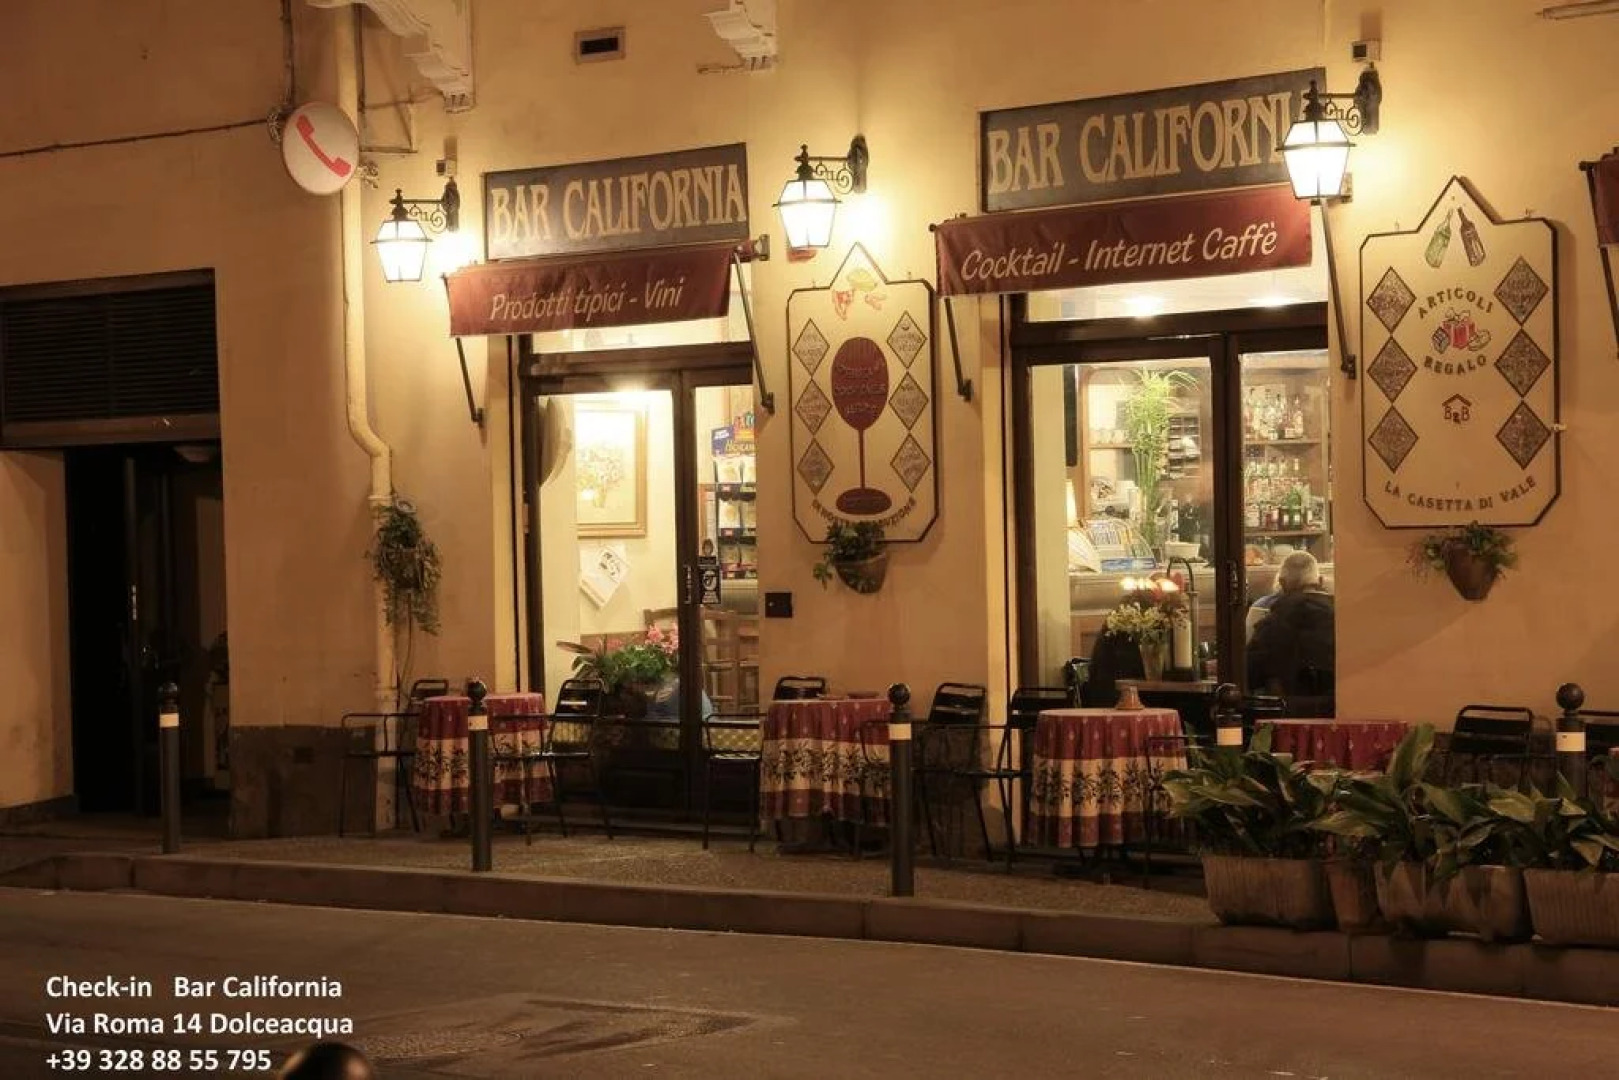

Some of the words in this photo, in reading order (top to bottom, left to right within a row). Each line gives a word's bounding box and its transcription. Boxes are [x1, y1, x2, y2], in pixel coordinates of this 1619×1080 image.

[986, 122, 1064, 194] BAR
[1079, 90, 1307, 183] CALIFORNI
[491, 184, 551, 242] BAR
[563, 163, 747, 240] CALIFORNIA
[961, 243, 1065, 281] Cocktail
[1084, 233, 1194, 271] Internet
[1202, 220, 1278, 261] Caffè
[491, 285, 569, 321] Prodotti
[573, 279, 627, 322] tipici
[645, 276, 685, 309] Vini
[1417, 287, 1494, 320] ARTICOLI
[1423, 354, 1487, 376] REGALO
[1384, 480, 1401, 498] LA
[1407, 493, 1473, 512] CASETTA
[1479, 496, 1494, 510] DI
[1499, 475, 1536, 503] VALE
